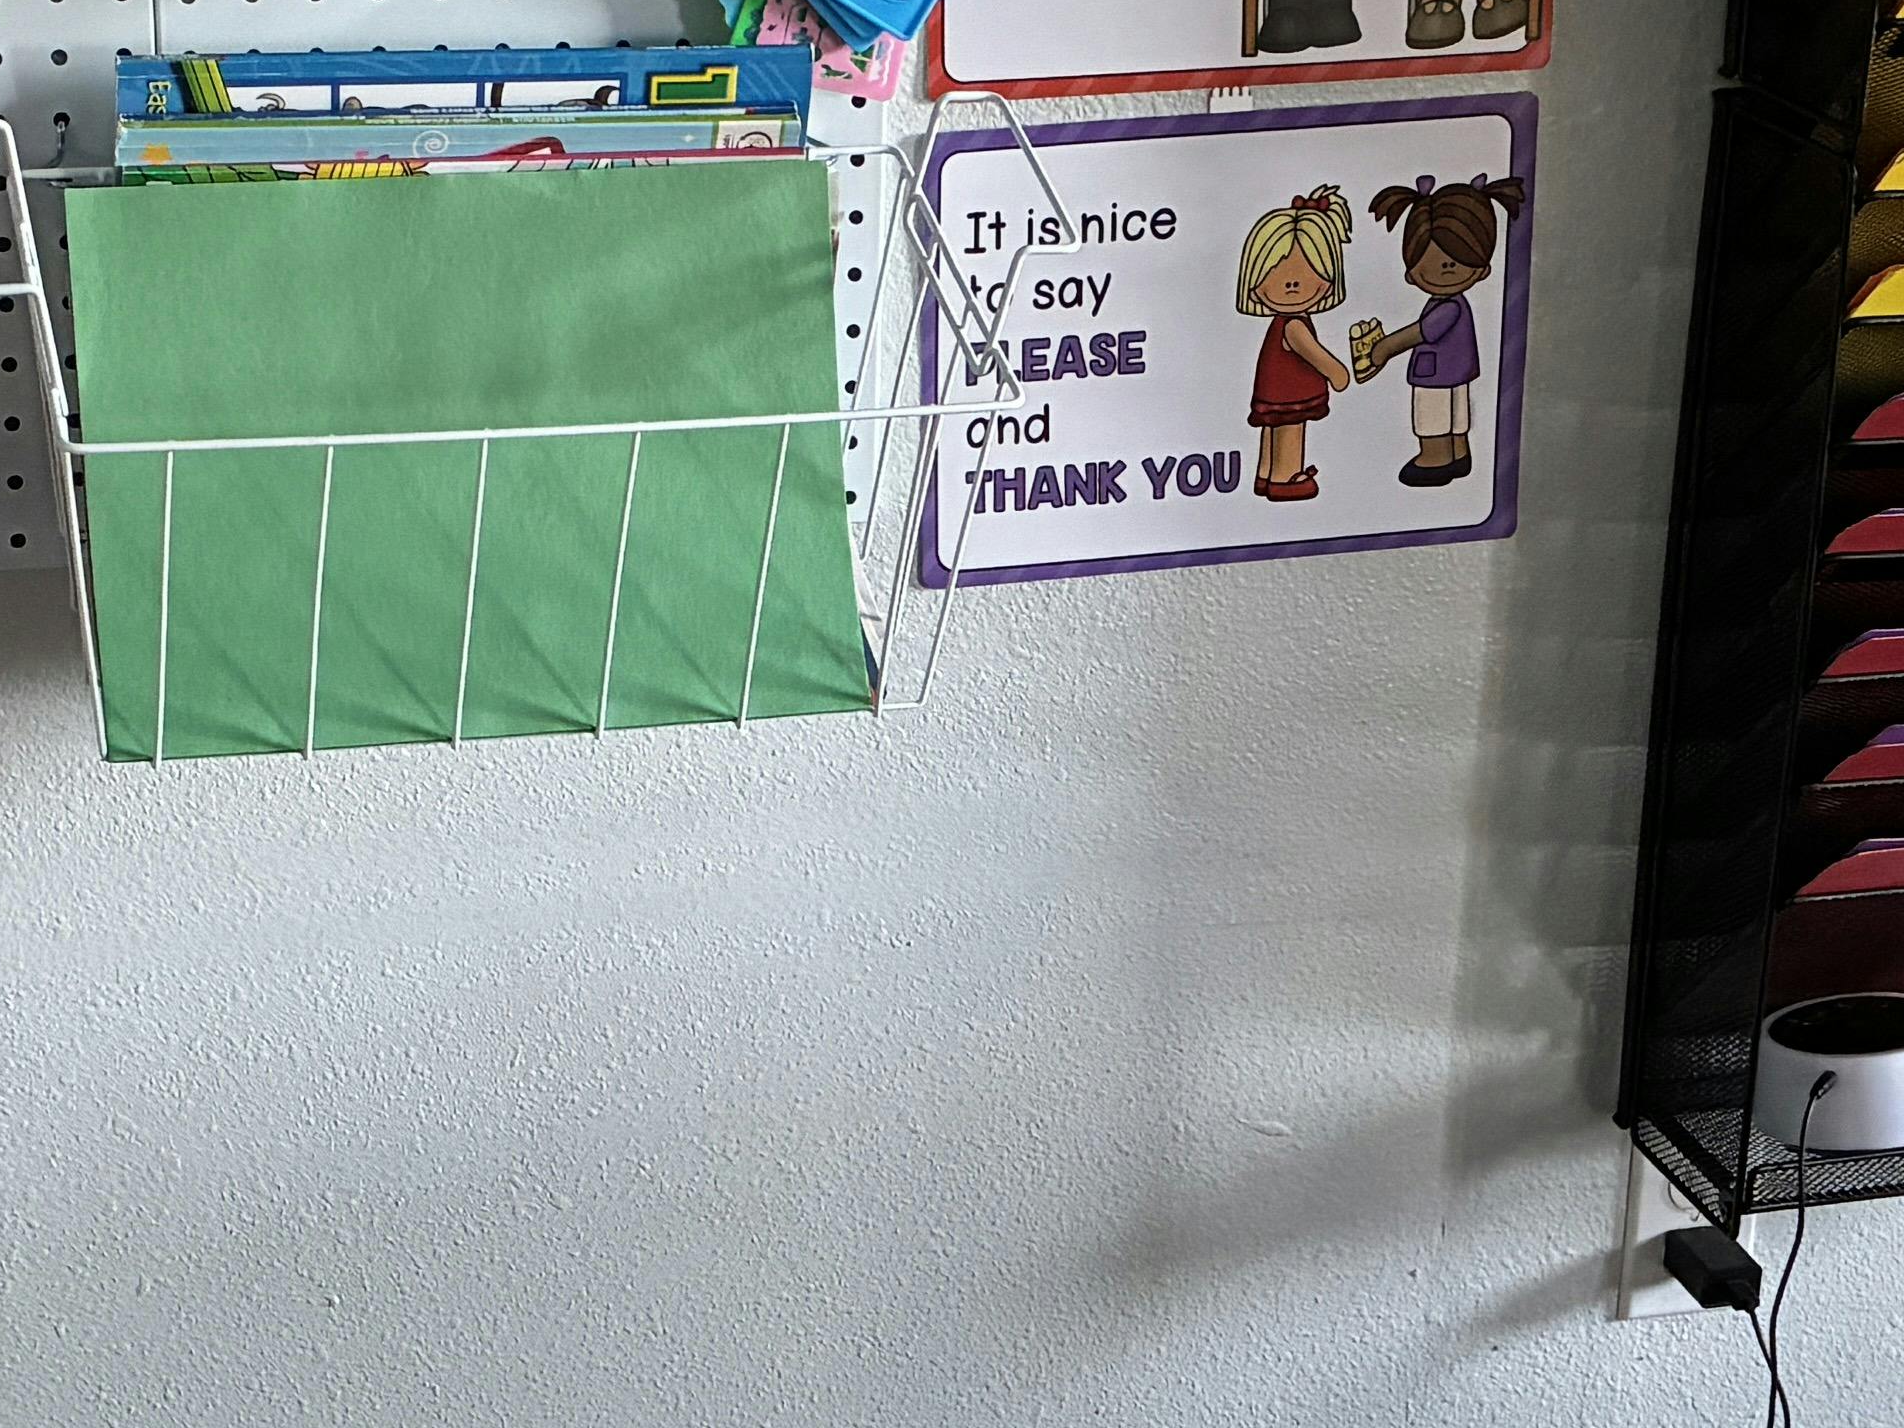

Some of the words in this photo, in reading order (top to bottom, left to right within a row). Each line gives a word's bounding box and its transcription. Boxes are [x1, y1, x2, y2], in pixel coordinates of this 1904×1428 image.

[965, 211, 1006, 255] It
[1026, 211, 1060, 247] is
[1082, 203, 1178, 245] nice
[1032, 271, 1112, 317] say
[966, 330, 1147, 385] PLEASE
[967, 404, 1051, 449] and
[964, 461, 1127, 514] THANK
[1141, 450, 1242, 500] YOU
